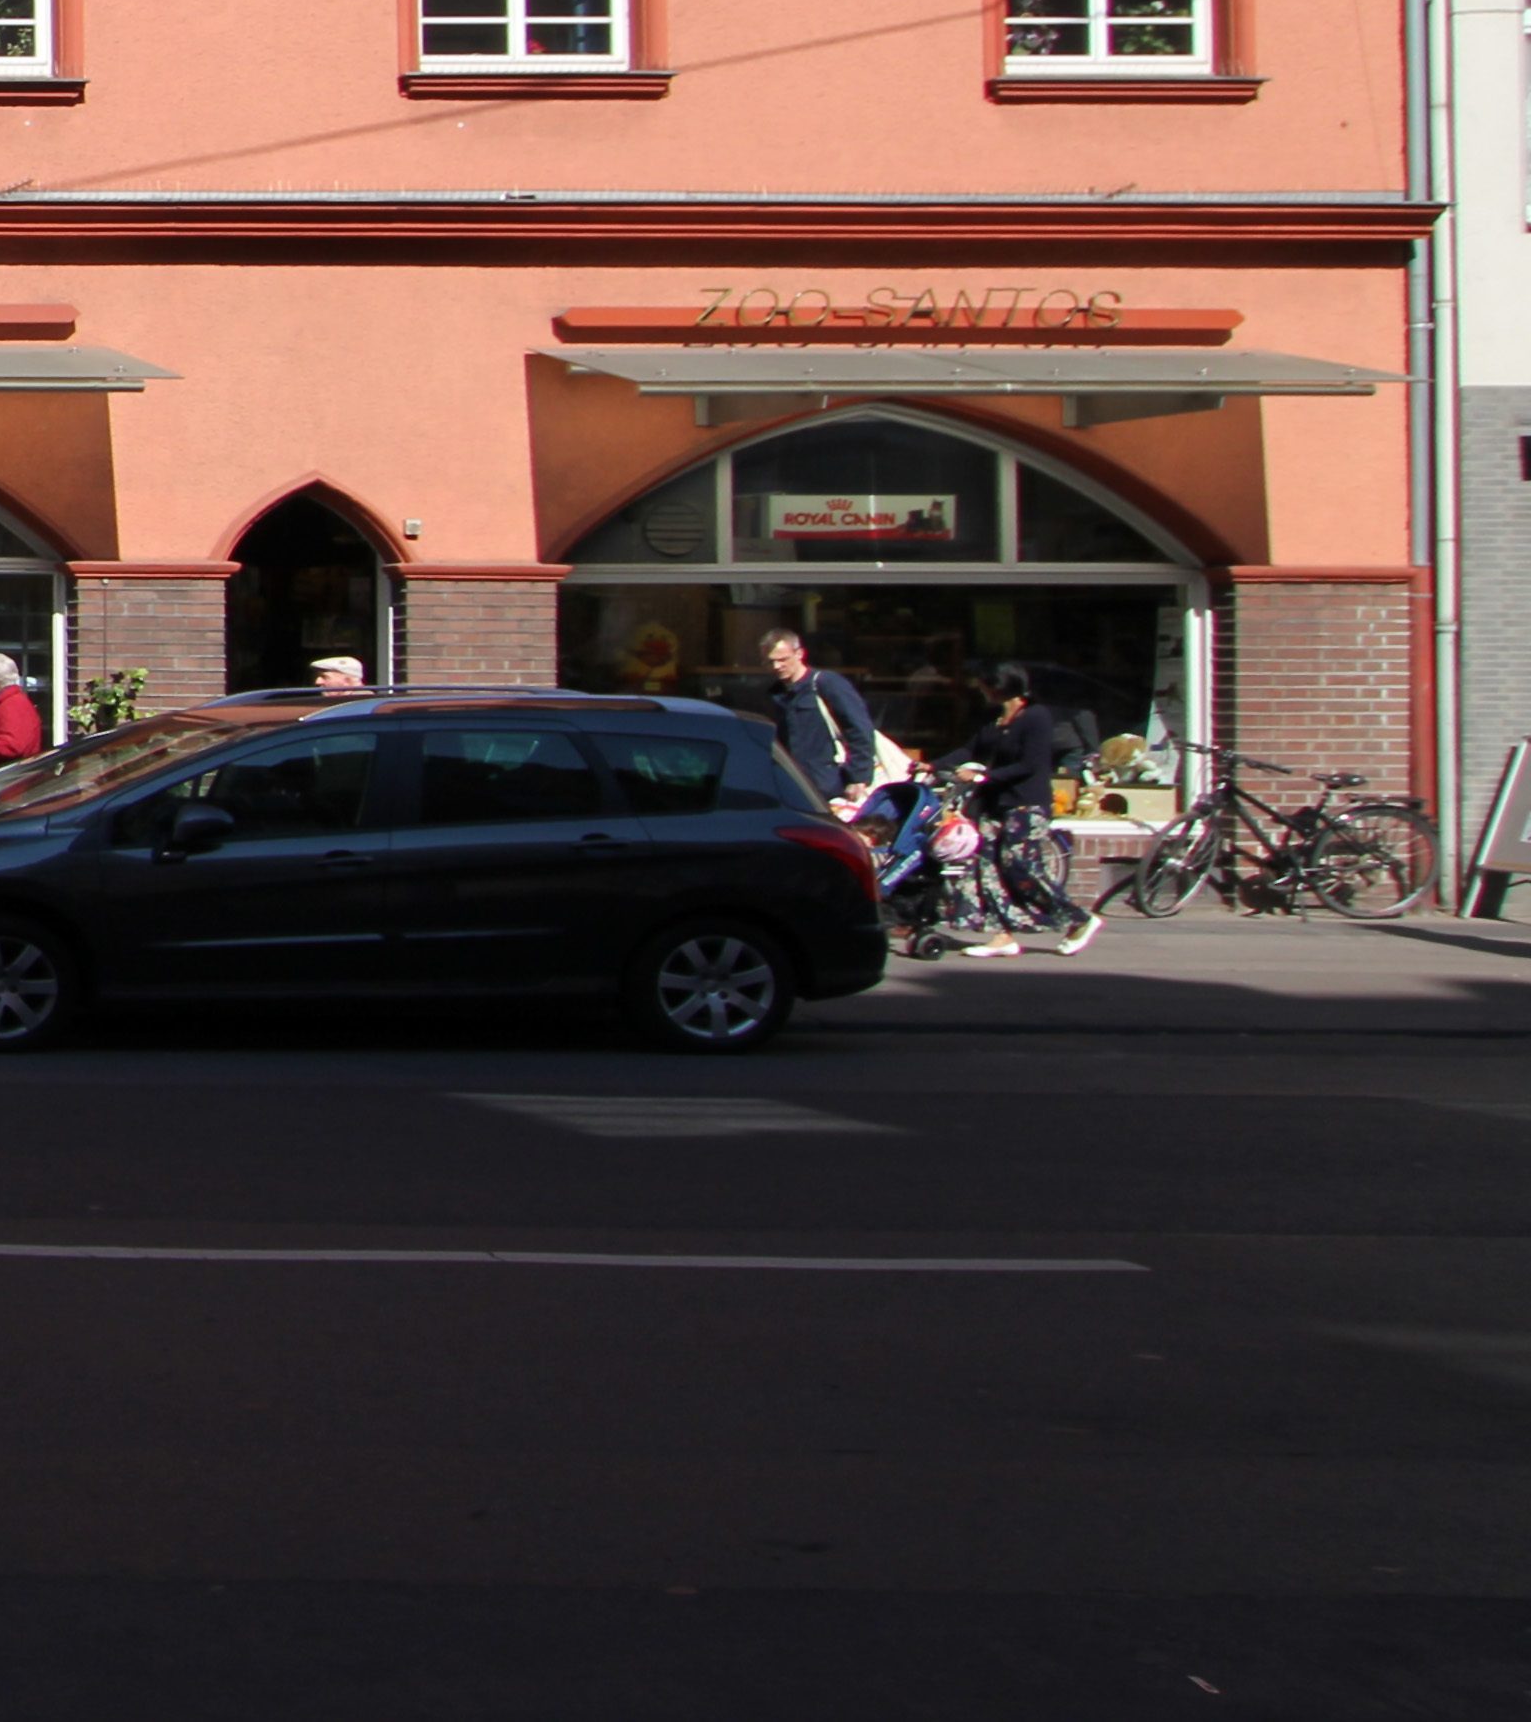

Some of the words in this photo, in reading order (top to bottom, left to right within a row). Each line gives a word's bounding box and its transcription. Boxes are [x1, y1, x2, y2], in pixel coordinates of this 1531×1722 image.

[691, 286, 1124, 329] ZOO-SANTOS
[784, 512, 836, 526] ROYAL
[840, 512, 896, 526] CANIN
